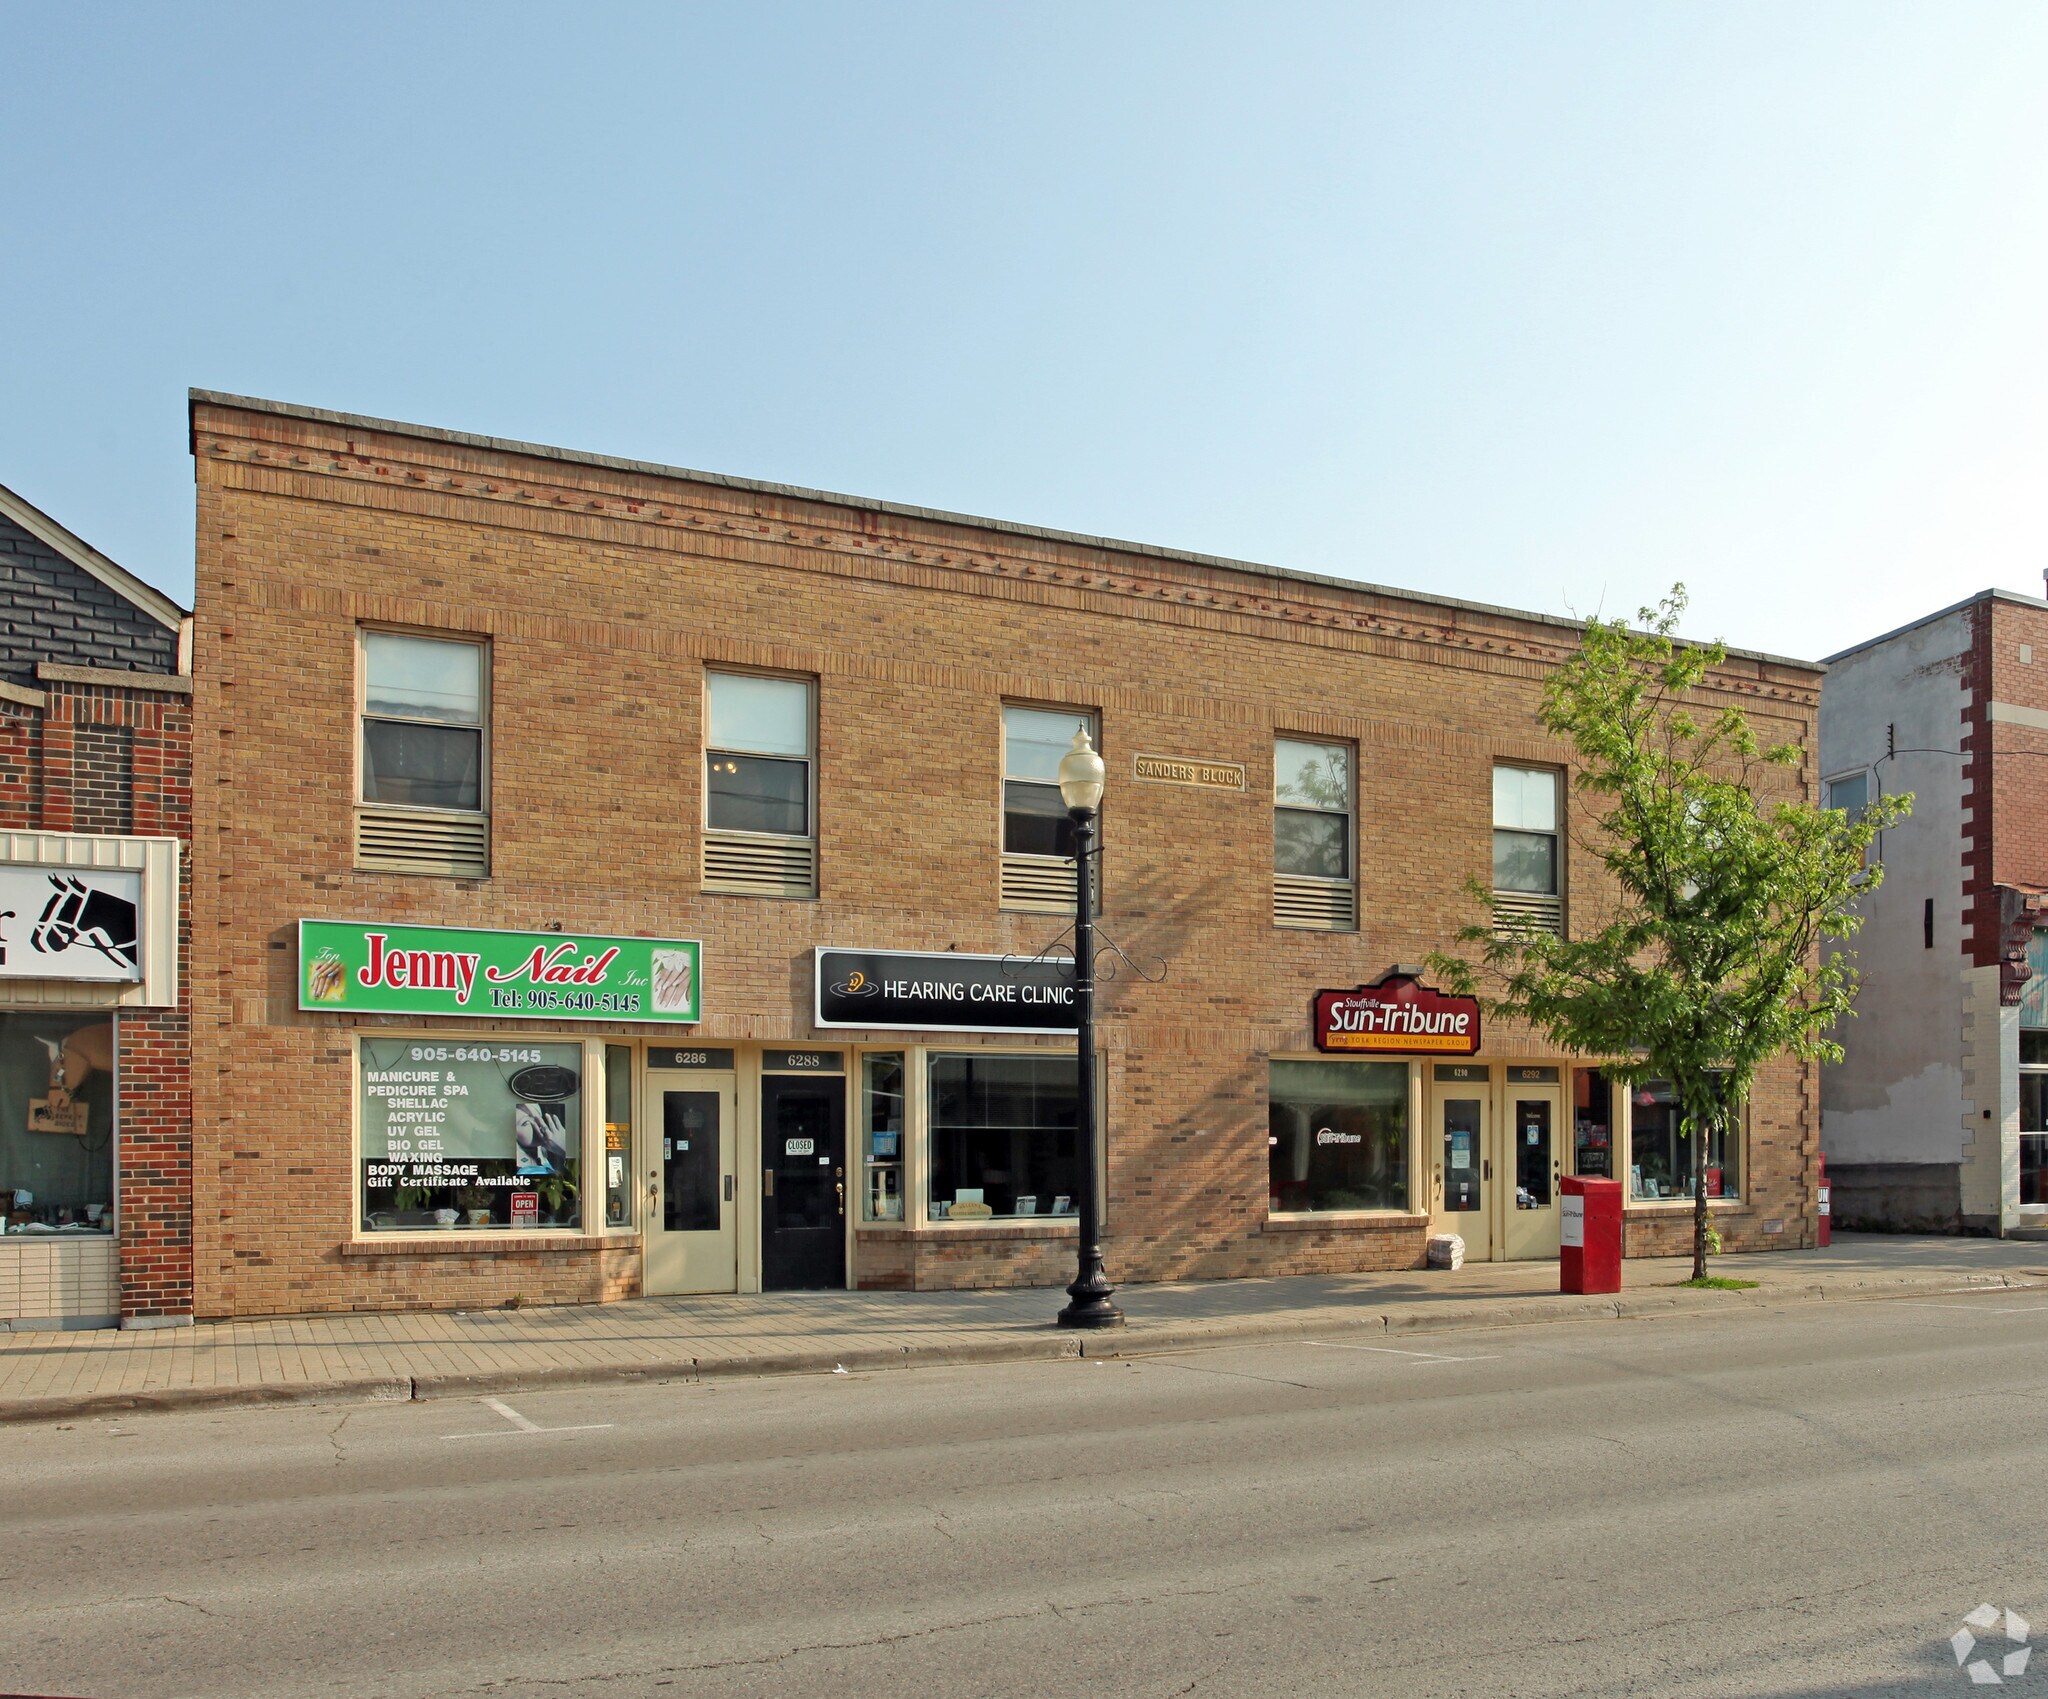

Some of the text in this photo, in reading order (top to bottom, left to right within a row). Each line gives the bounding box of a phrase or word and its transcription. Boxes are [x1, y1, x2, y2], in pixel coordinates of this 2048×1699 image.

[1137, 761, 1242, 785] SANDERS BLOCK
[315, 932, 649, 1005] Top Jenny Nail Inc
[884, 980, 1074, 1005] HEARING CARE CLINIC
[489, 988, 640, 1012] Tel: 905-640-5145
[1345, 998, 1380, 1010] Stouffville
[1329, 1001, 1470, 1034] Sun-Tribune
[1373, 1037, 1400, 1045] REGION
[1404, 1038, 1443, 1046] NEWSPAPER
[1447, 1039, 1469, 1047] GROUP
[411, 1048, 541, 1063] 905-640-5145
[675, 1052, 707, 1064] 6286
[787, 1055, 820, 1067] 6288
[367, 1072, 456, 1083] MANICURE &
[1522, 1070, 1540, 1079] 6292
[367, 1085, 469, 1096] PEDICURE SPA
[387, 1098, 448, 1109] SHELLAC
[387, 1112, 446, 1123] ACRYLIC
[387, 1126, 440, 1137] UV GEL
[387, 1140, 444, 1150] BIO GEL
[788, 1140, 812, 1150] CLOSED
[388, 1153, 443, 1163] WAXING
[368, 1165, 478, 1176] BODY MASSAGE
[367, 1176, 531, 1188] Gift Certificate Available
[1818, 1189, 1828, 1202] UN
[515, 1199, 534, 1208] OPEN
